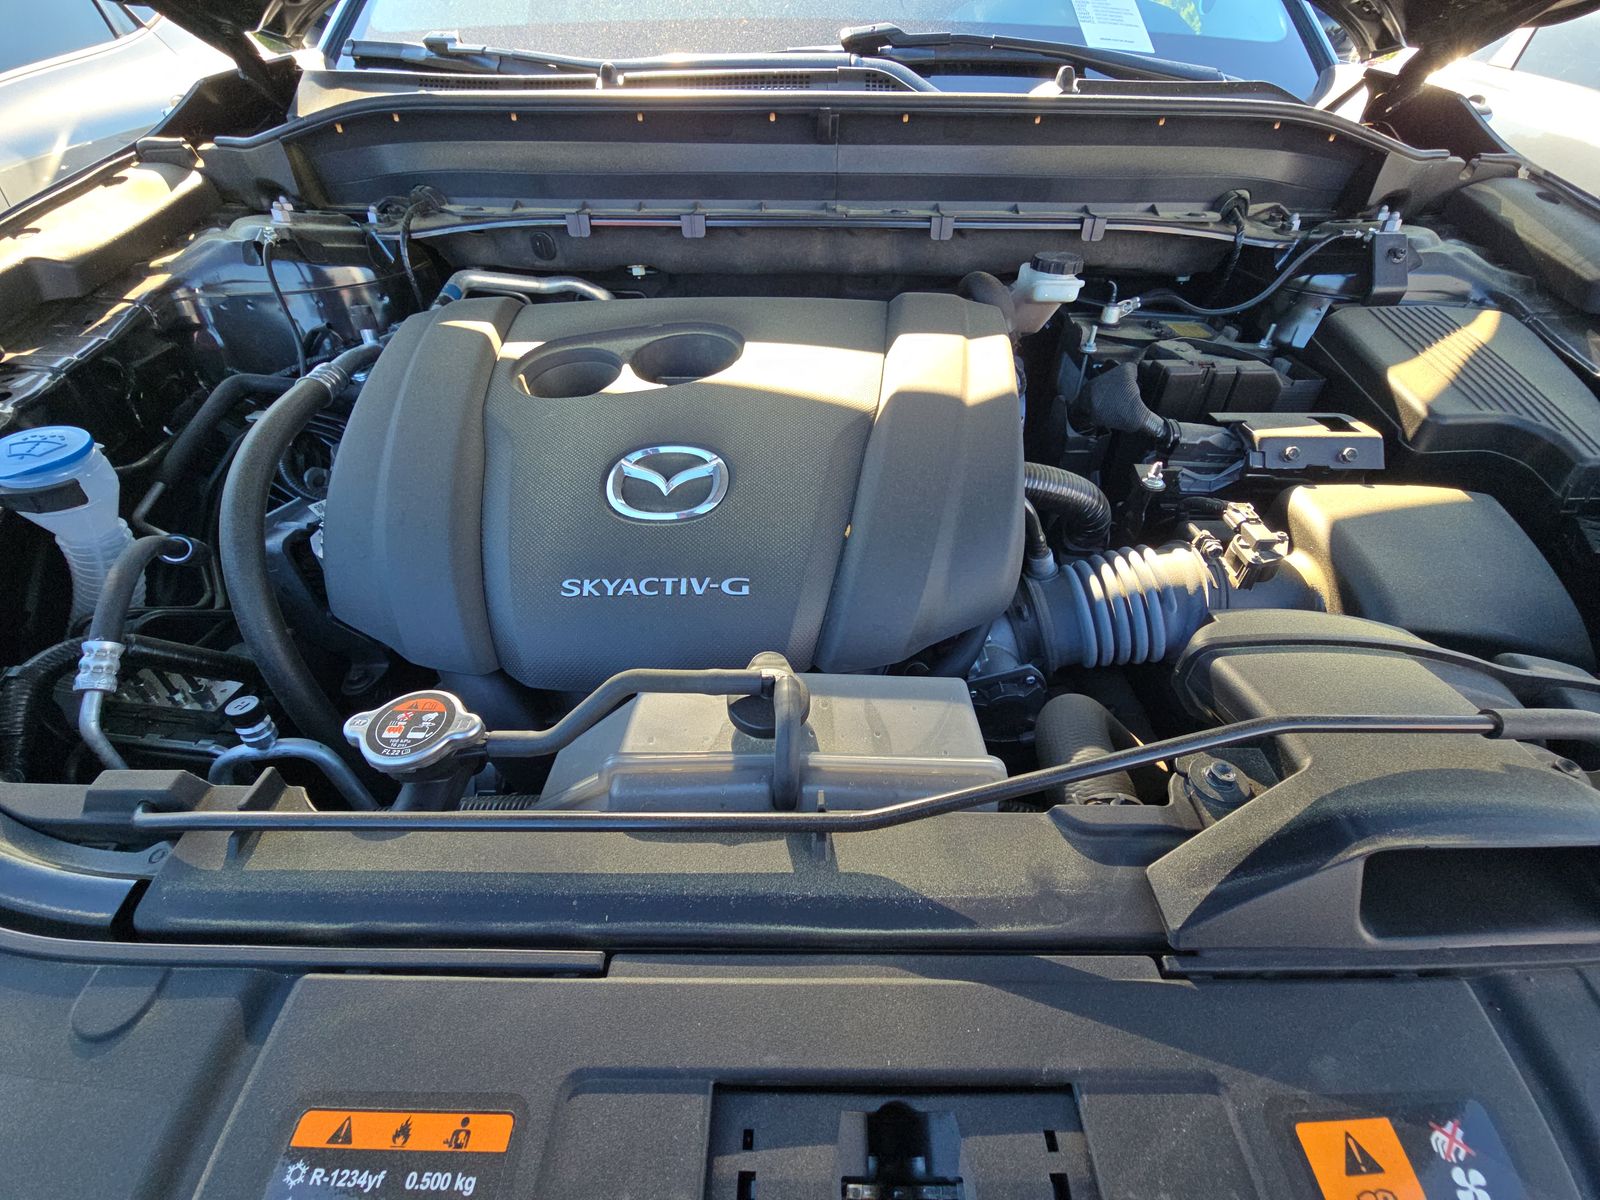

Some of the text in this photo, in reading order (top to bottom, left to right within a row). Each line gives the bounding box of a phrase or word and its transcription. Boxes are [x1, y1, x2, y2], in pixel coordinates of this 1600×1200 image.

[560, 577, 750, 597] SKYACTIV-G
[309, 1168, 477, 1197] R-1234yf 0.500 kg
